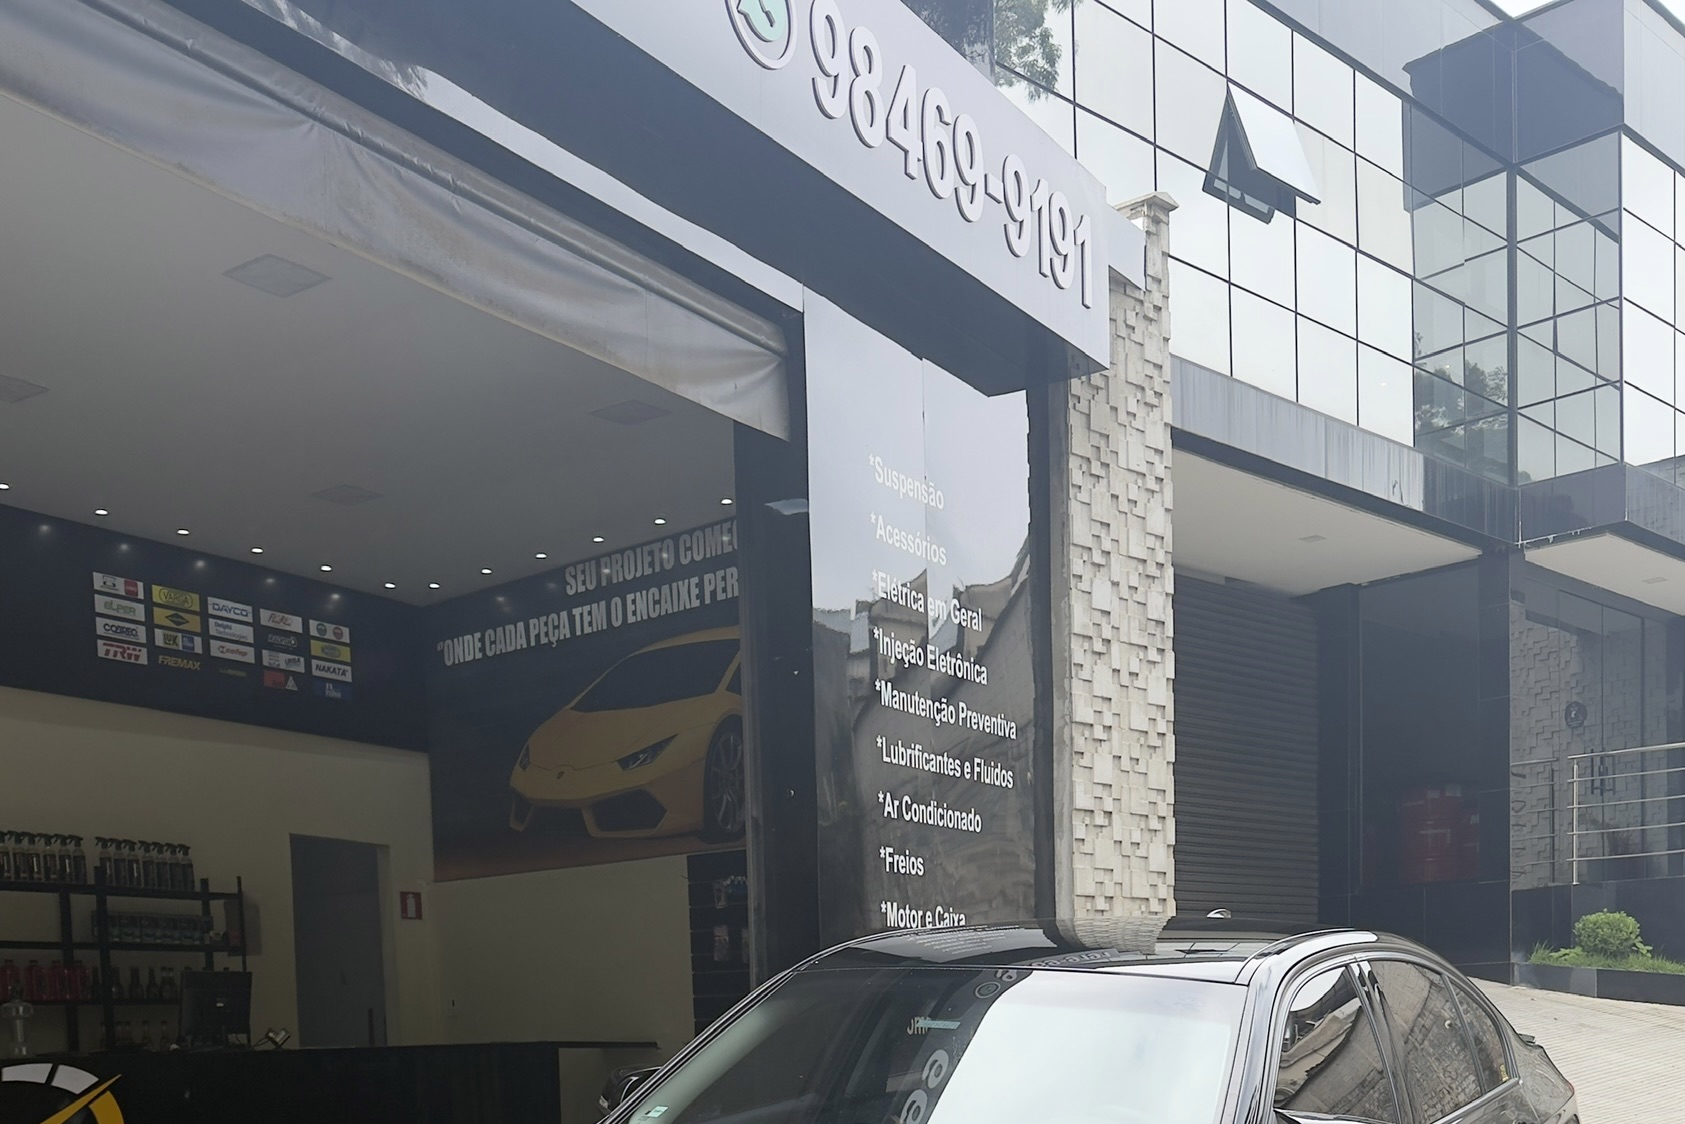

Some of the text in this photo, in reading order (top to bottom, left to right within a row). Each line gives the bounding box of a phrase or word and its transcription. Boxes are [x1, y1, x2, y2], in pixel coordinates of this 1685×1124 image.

[809, 0, 1093, 310] 98469-9191
[565, 519, 738, 596] SEU PROJETO COME
[212, 602, 248, 617] DAYCO
[484, 621, 527, 657] CADA
[529, 610, 571, 648] PEÇA
[572, 600, 607, 636] TEM
[610, 597, 623, 627] O
[626, 576, 701, 624] ENCAIXE
[703, 566, 739, 605] PER
[927, 599, 947, 621] em
[950, 598, 983, 632] Geral
[103, 642, 142, 662] TRW
[159, 655, 201, 671] FREMAX
[926, 644, 988, 685] Eletrônica
[315, 663, 347, 678] NAKATA
[958, 701, 1017, 740] Preventiva
[963, 763, 971, 780] e
[973, 757, 1014, 789] Fluidos
[902, 794, 983, 834] Condicionado
[925, 911, 933, 928] e
[935, 905, 967, 928] Caixa
